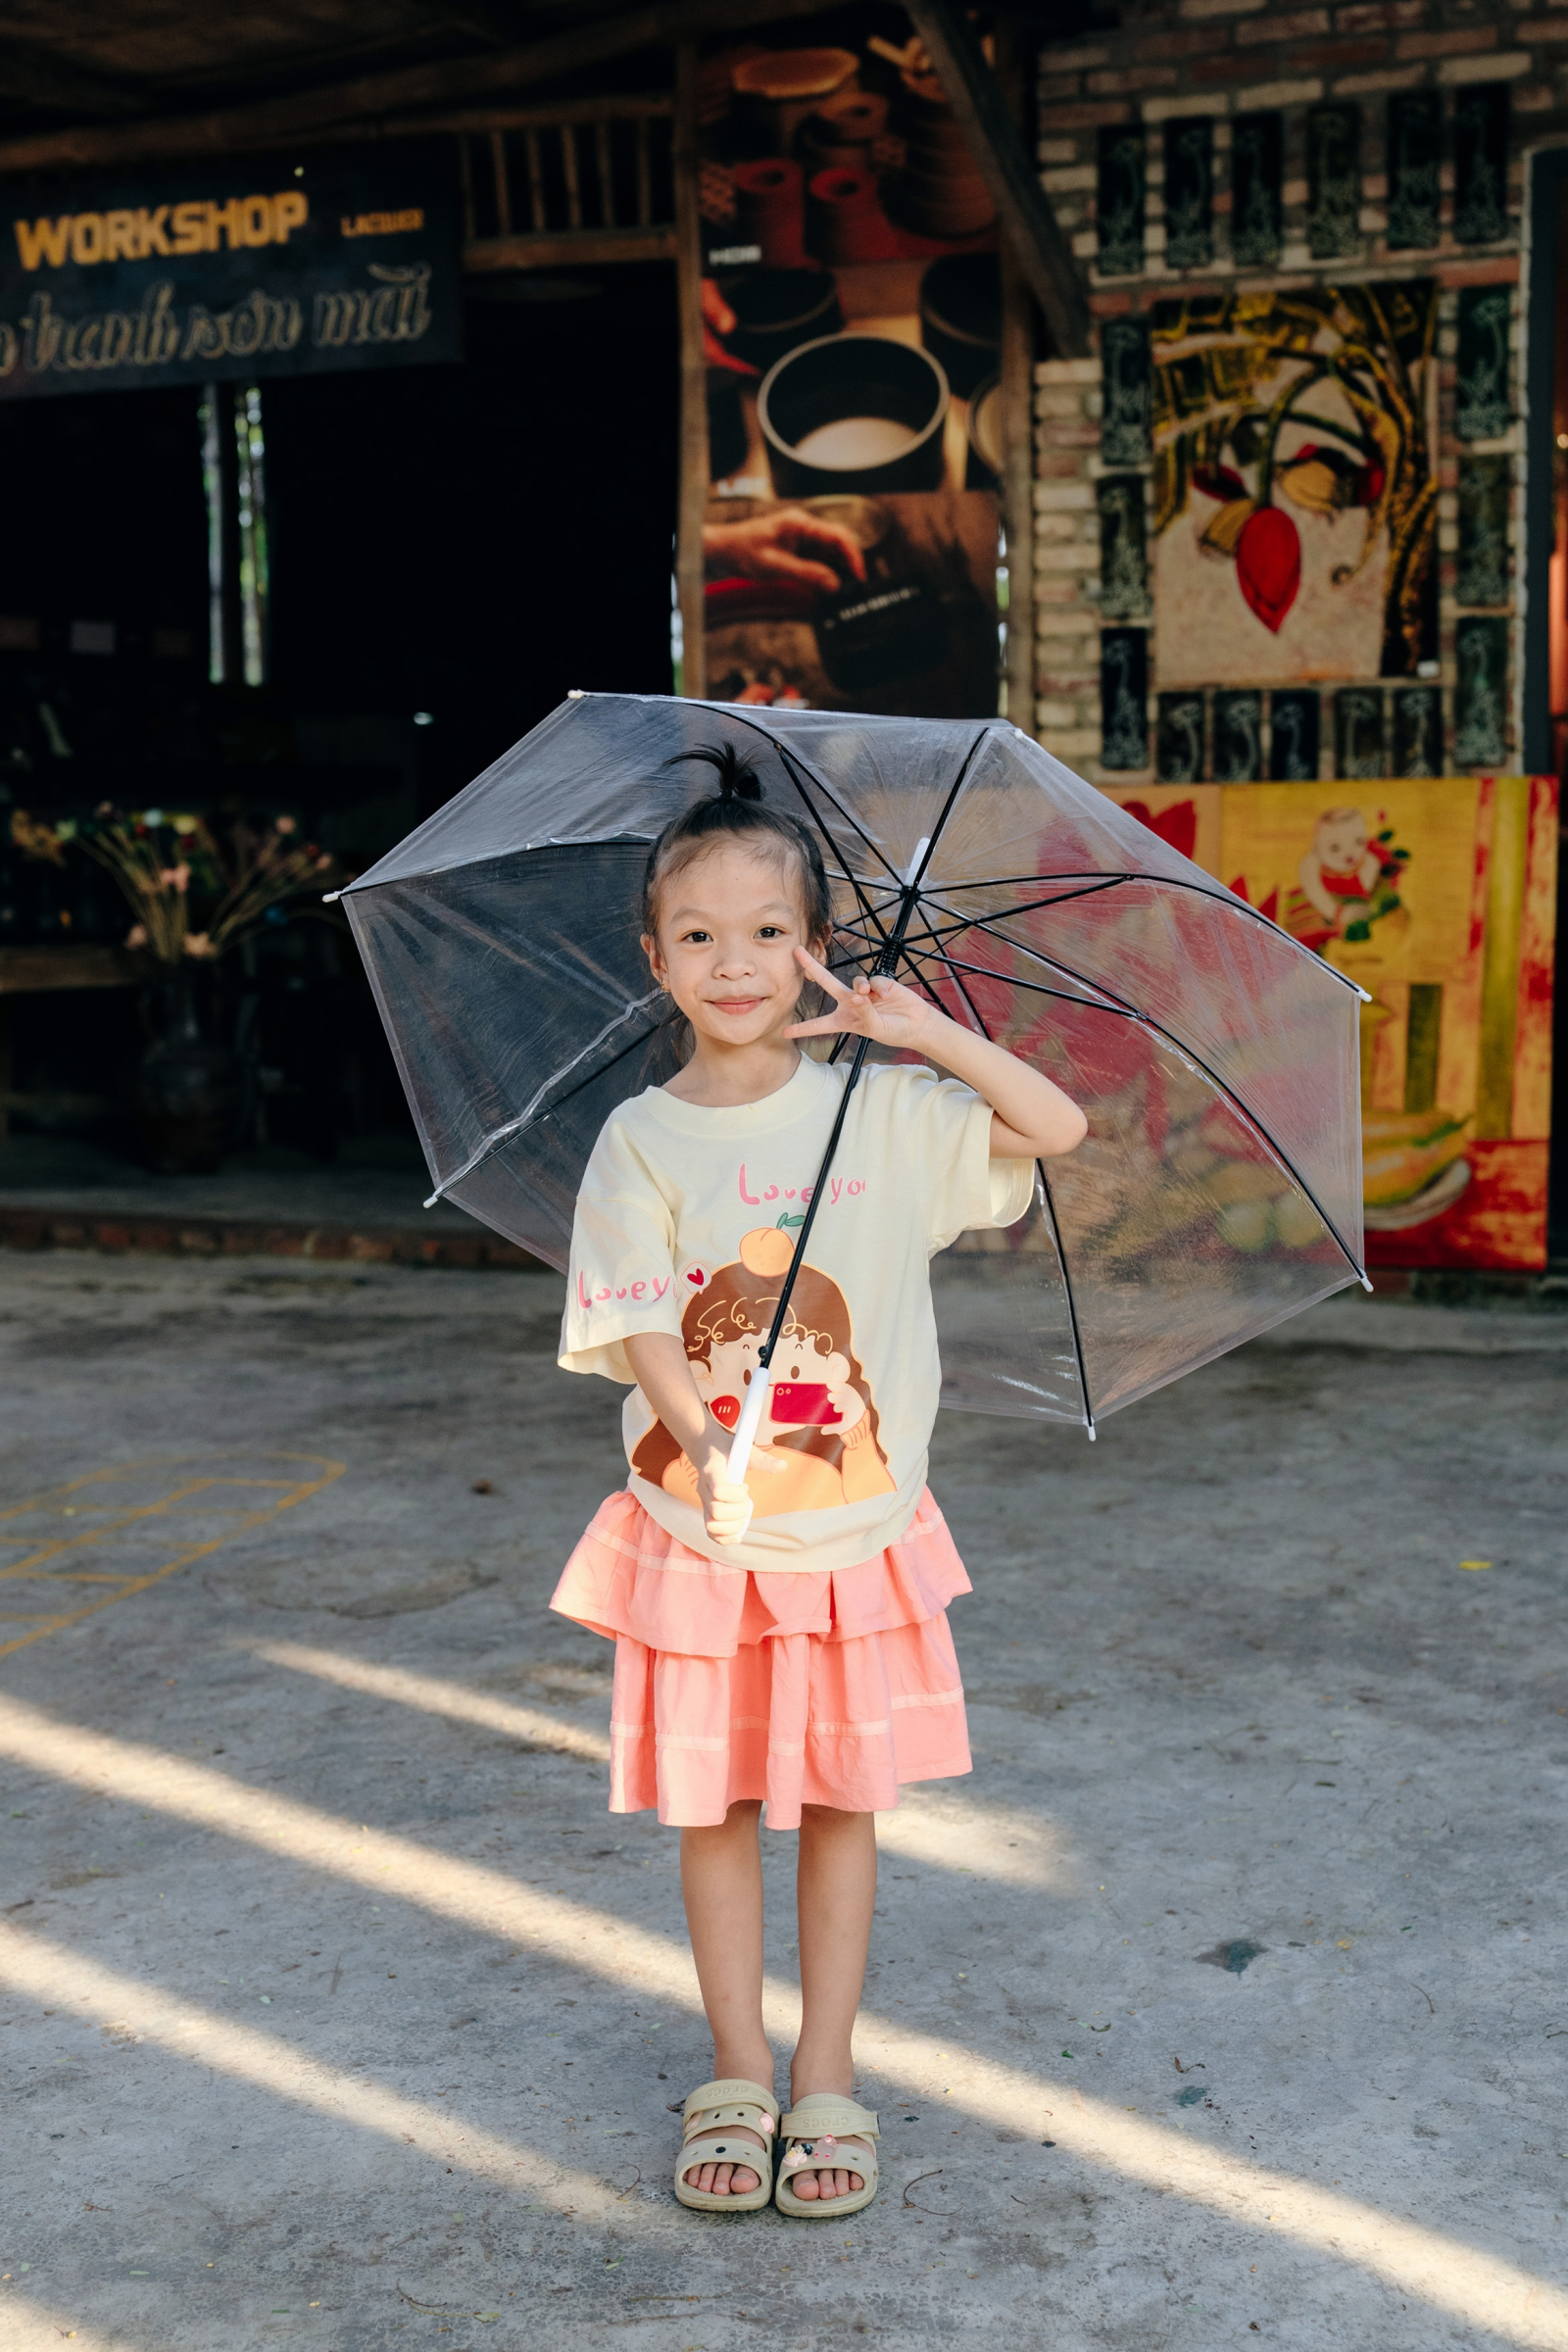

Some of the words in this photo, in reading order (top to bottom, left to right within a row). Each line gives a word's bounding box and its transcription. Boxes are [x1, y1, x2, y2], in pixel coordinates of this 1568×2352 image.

[13, 190, 309, 271] WORKSHOP
[739, 1162, 814, 1205] Love
[706, 2086, 749, 2099] crocs
[803, 2115, 851, 2129] crocs
